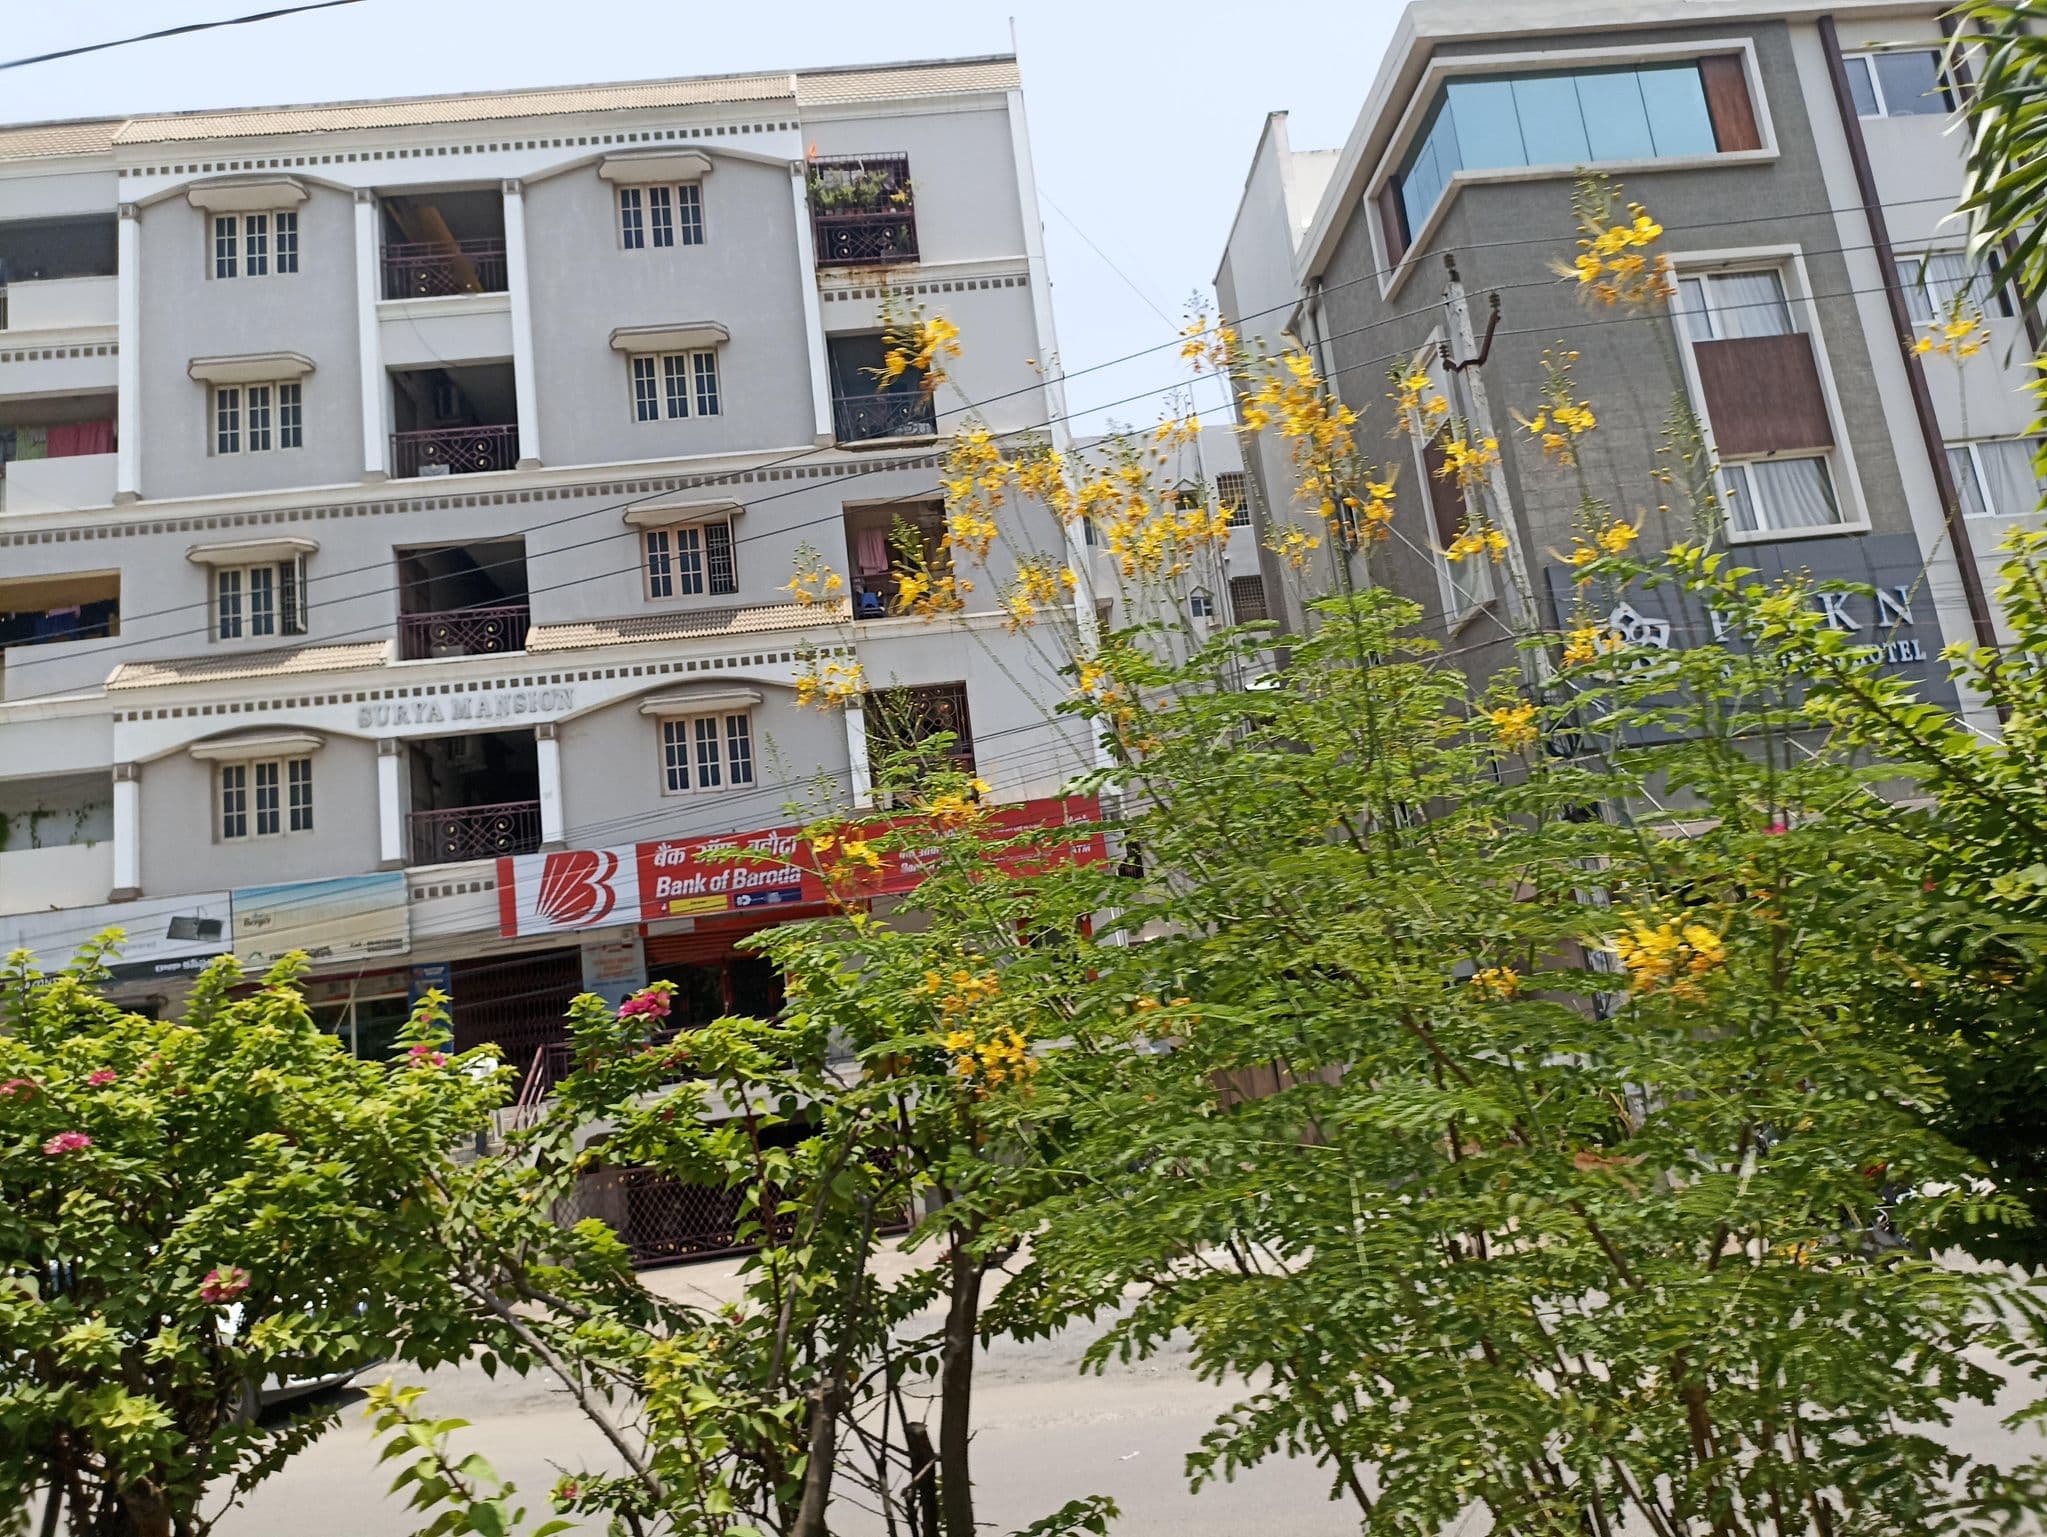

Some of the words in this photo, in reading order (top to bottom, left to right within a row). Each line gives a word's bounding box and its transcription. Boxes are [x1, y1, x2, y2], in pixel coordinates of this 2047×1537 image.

[357, 701, 445, 728] SURYA
[450, 689, 575, 721] MANSION
[653, 842, 686, 867] बैंक
[655, 872, 707, 898] Bank
[710, 868, 730, 891] of
[732, 866, 801, 889] Baroda
